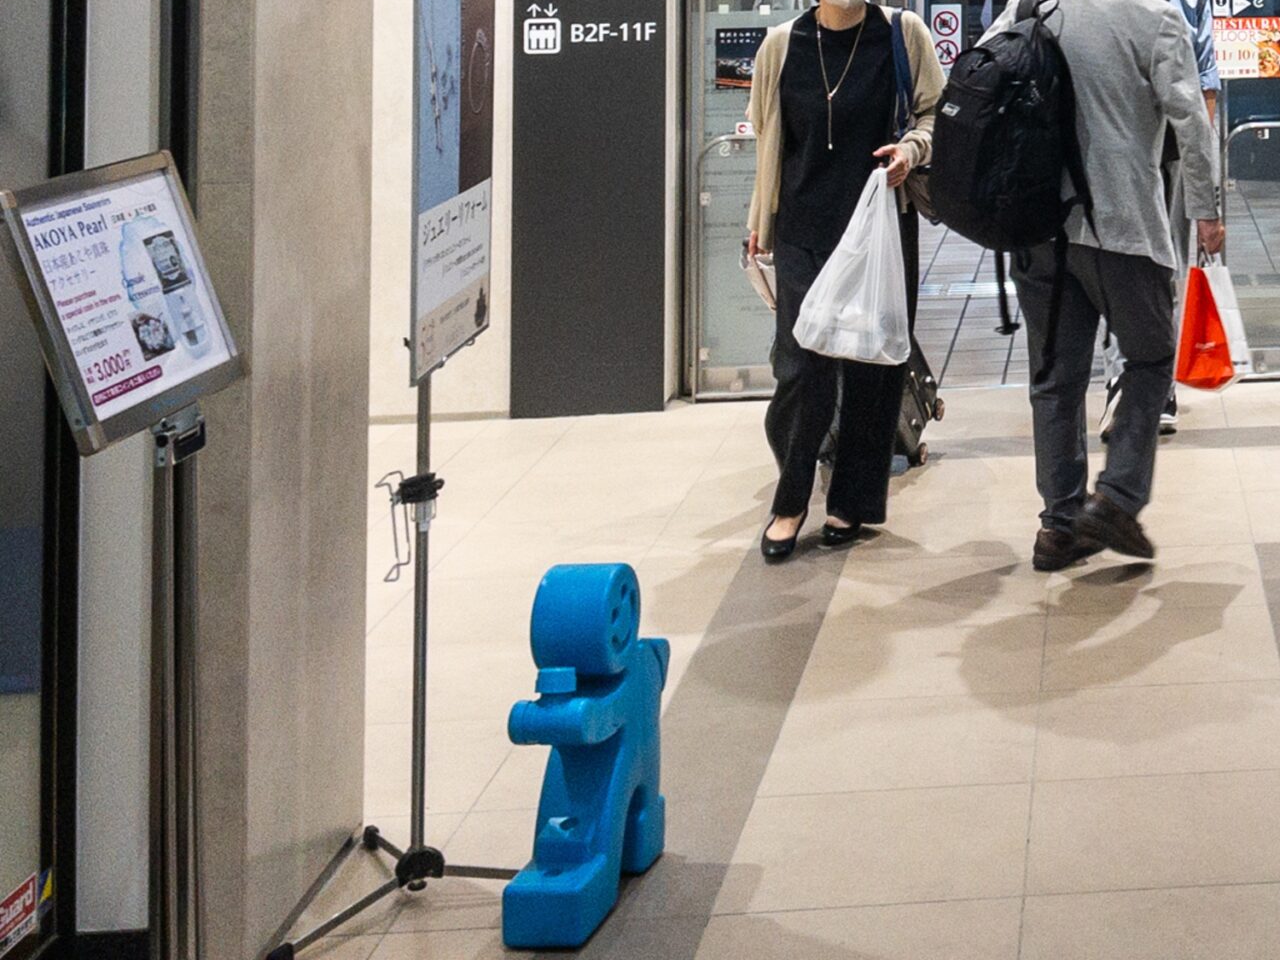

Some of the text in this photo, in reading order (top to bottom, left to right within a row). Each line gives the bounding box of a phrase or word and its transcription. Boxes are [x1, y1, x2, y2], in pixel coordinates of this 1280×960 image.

[570, 22, 656, 43] B2F-11F
[1214, 30, 1256, 42] FLOOR
[32, 214, 107, 252] AKOYA Pearl
[94, 353, 125, 382] 3,000
